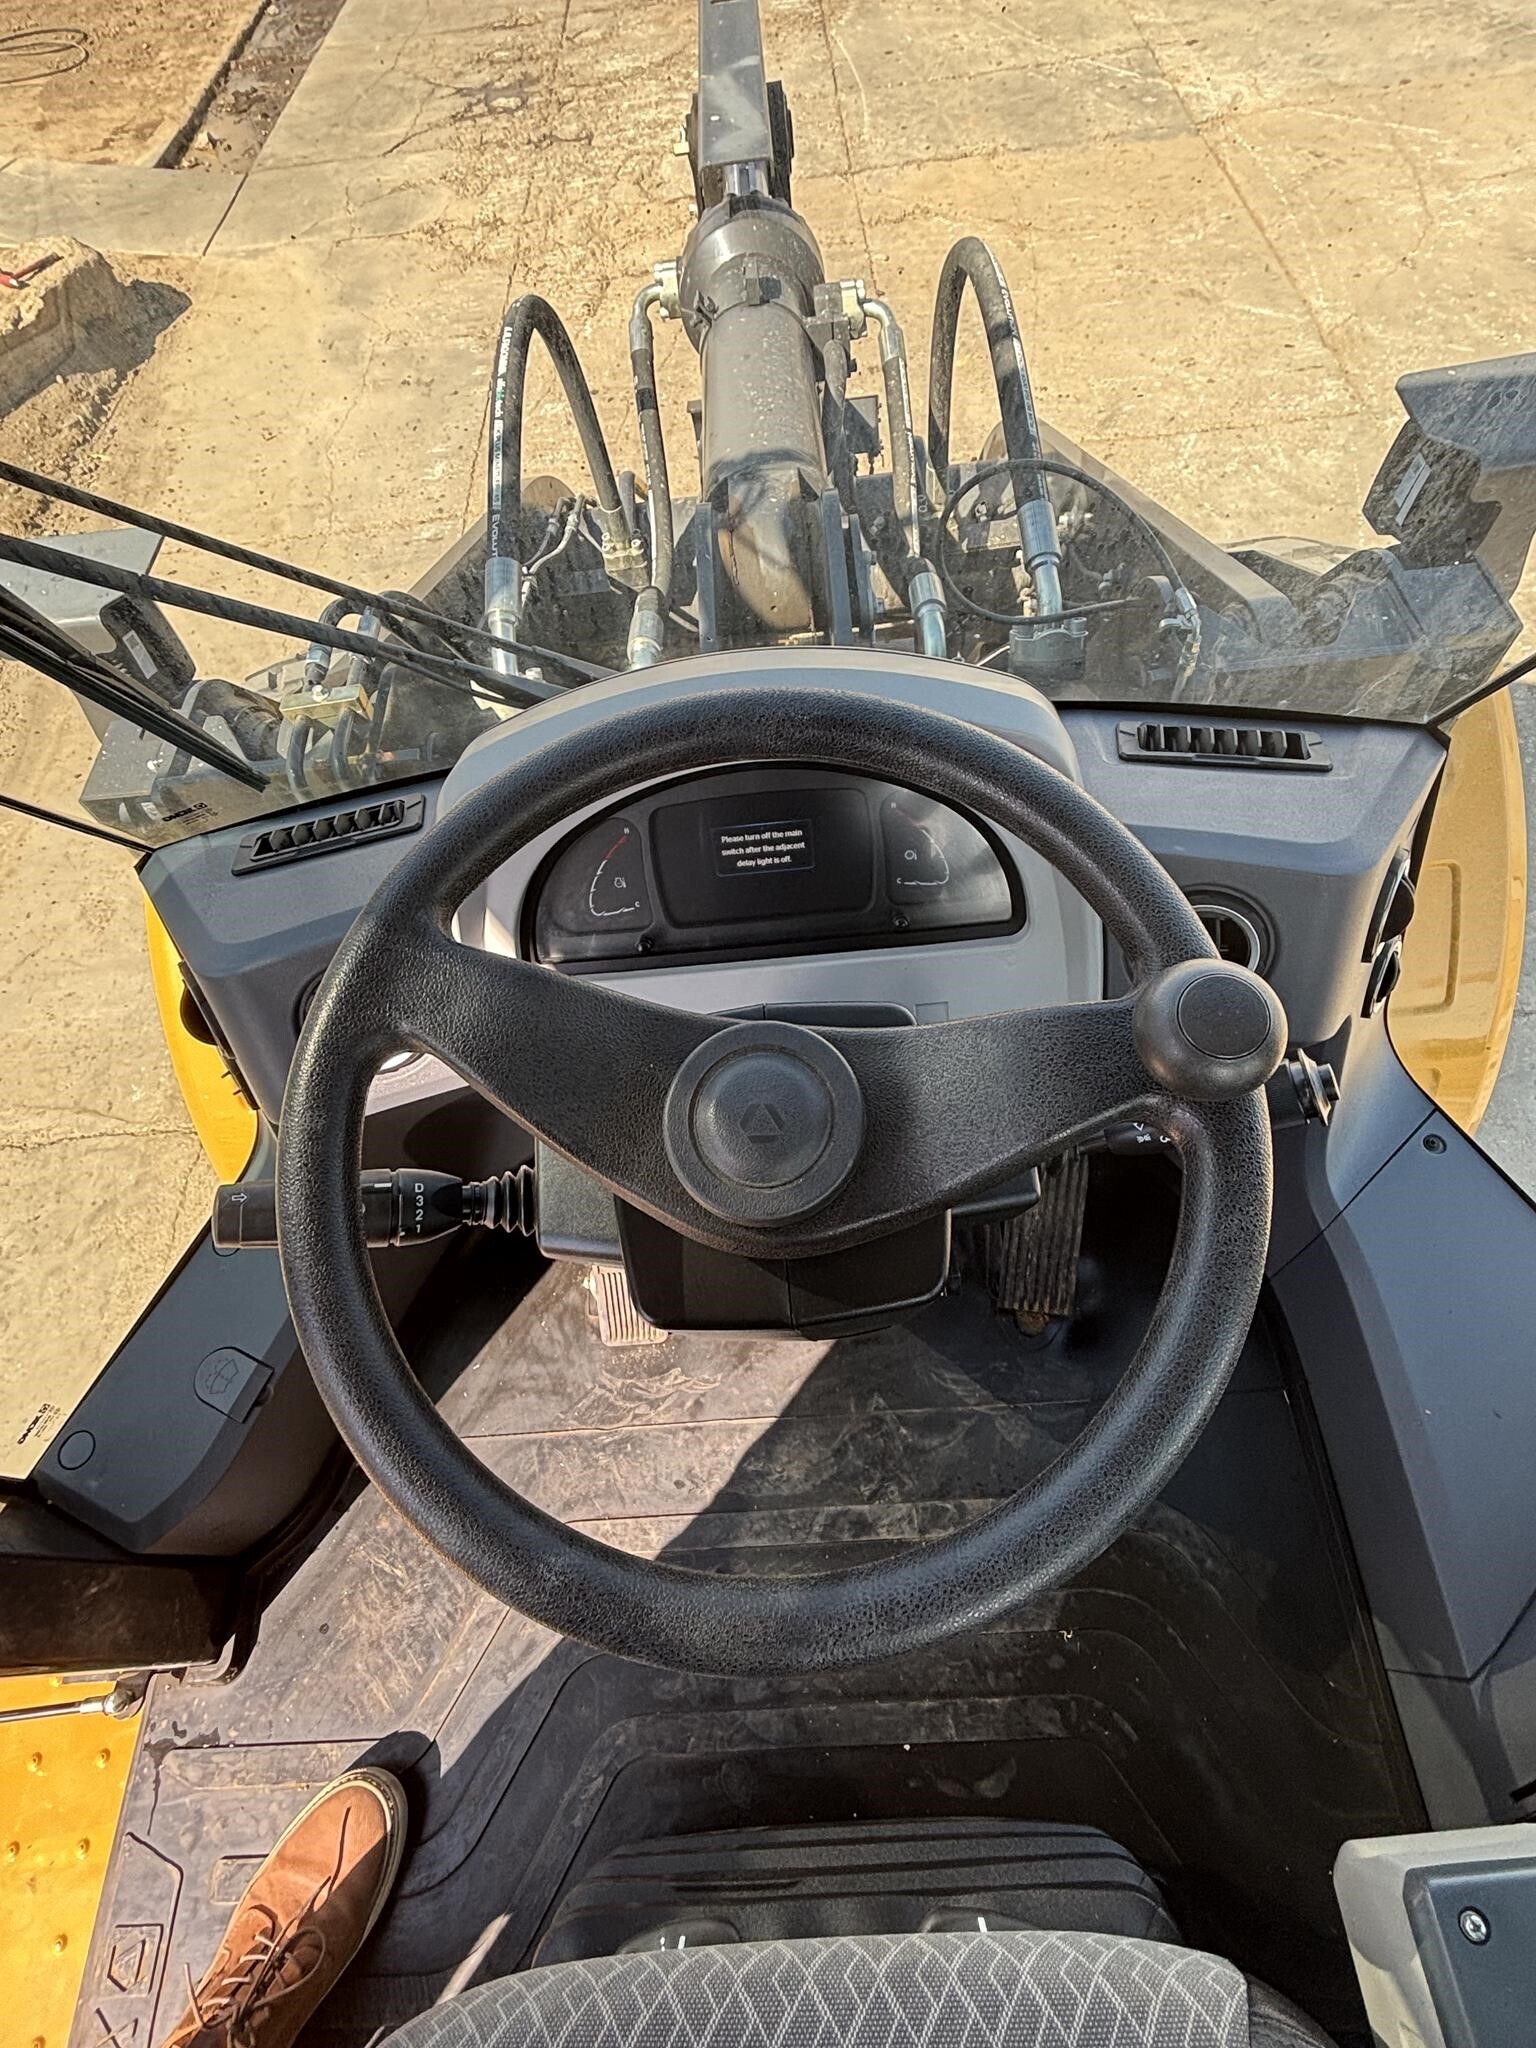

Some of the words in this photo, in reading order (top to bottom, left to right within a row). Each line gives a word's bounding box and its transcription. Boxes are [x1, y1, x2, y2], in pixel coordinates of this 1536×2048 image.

[721, 835, 744, 843] Please
[745, 833, 760, 841] turn
[761, 831, 771, 839] off
[785, 829, 803, 837] main
[721, 848, 744, 856] switch
[745, 846, 762, 854] after
[775, 842, 806, 852] adjacent
[736, 859, 756, 867] delay
[757, 857, 773, 866] light
[415, 1183, 424, 1193] D
[415, 1195, 424, 1206] 3
[415, 1209, 424, 1220] 2
[416, 1224, 421, 1233] 1
